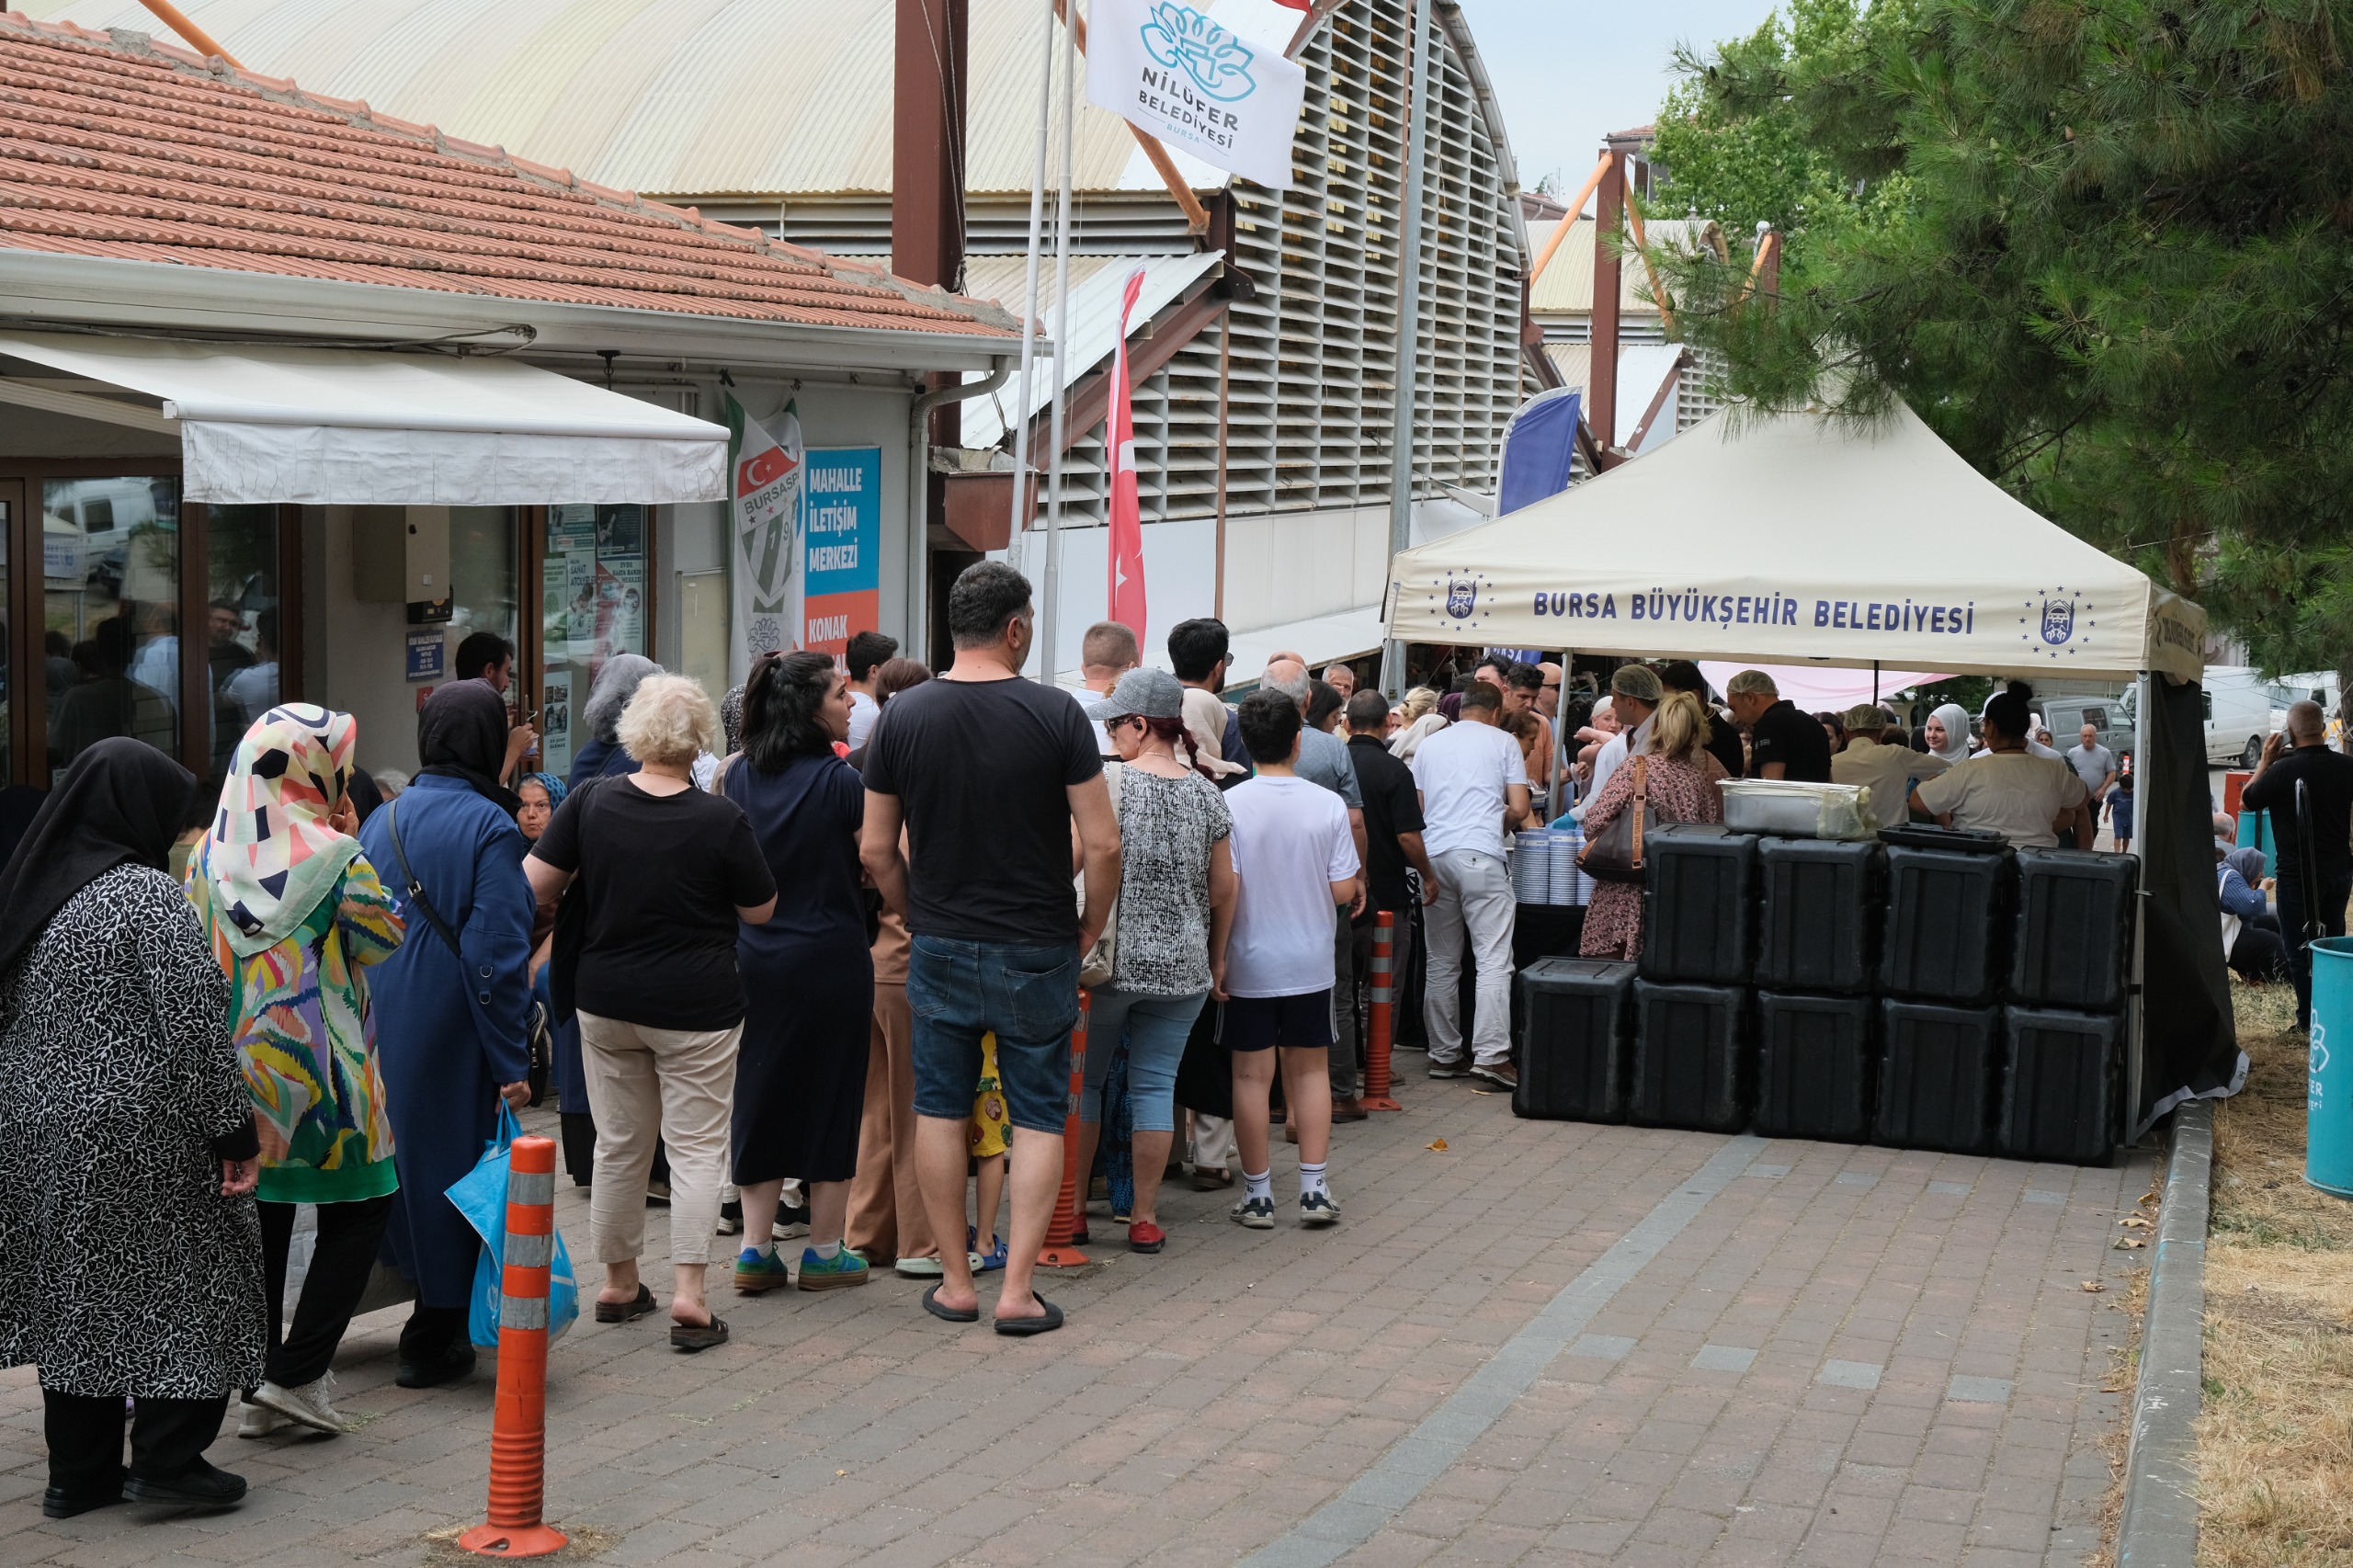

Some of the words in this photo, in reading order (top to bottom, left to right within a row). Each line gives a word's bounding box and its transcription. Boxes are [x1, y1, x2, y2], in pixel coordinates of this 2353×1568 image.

[1142, 66, 1239, 131] NİLÜFER
[1139, 90, 1233, 149] BELEDİYESİ
[1166, 123, 1200, 143] BURSA
[809, 467, 862, 494] MAHALLE
[809, 499, 858, 537] İLETİŞİM
[809, 538, 858, 572] MERKEZİ
[808, 614, 847, 643] KONAK
[1533, 592, 1618, 619] BURSA
[1631, 586, 1799, 631] BÜYÜKŞEHİR
[1813, 598, 1974, 635] BELEDİYESİ
